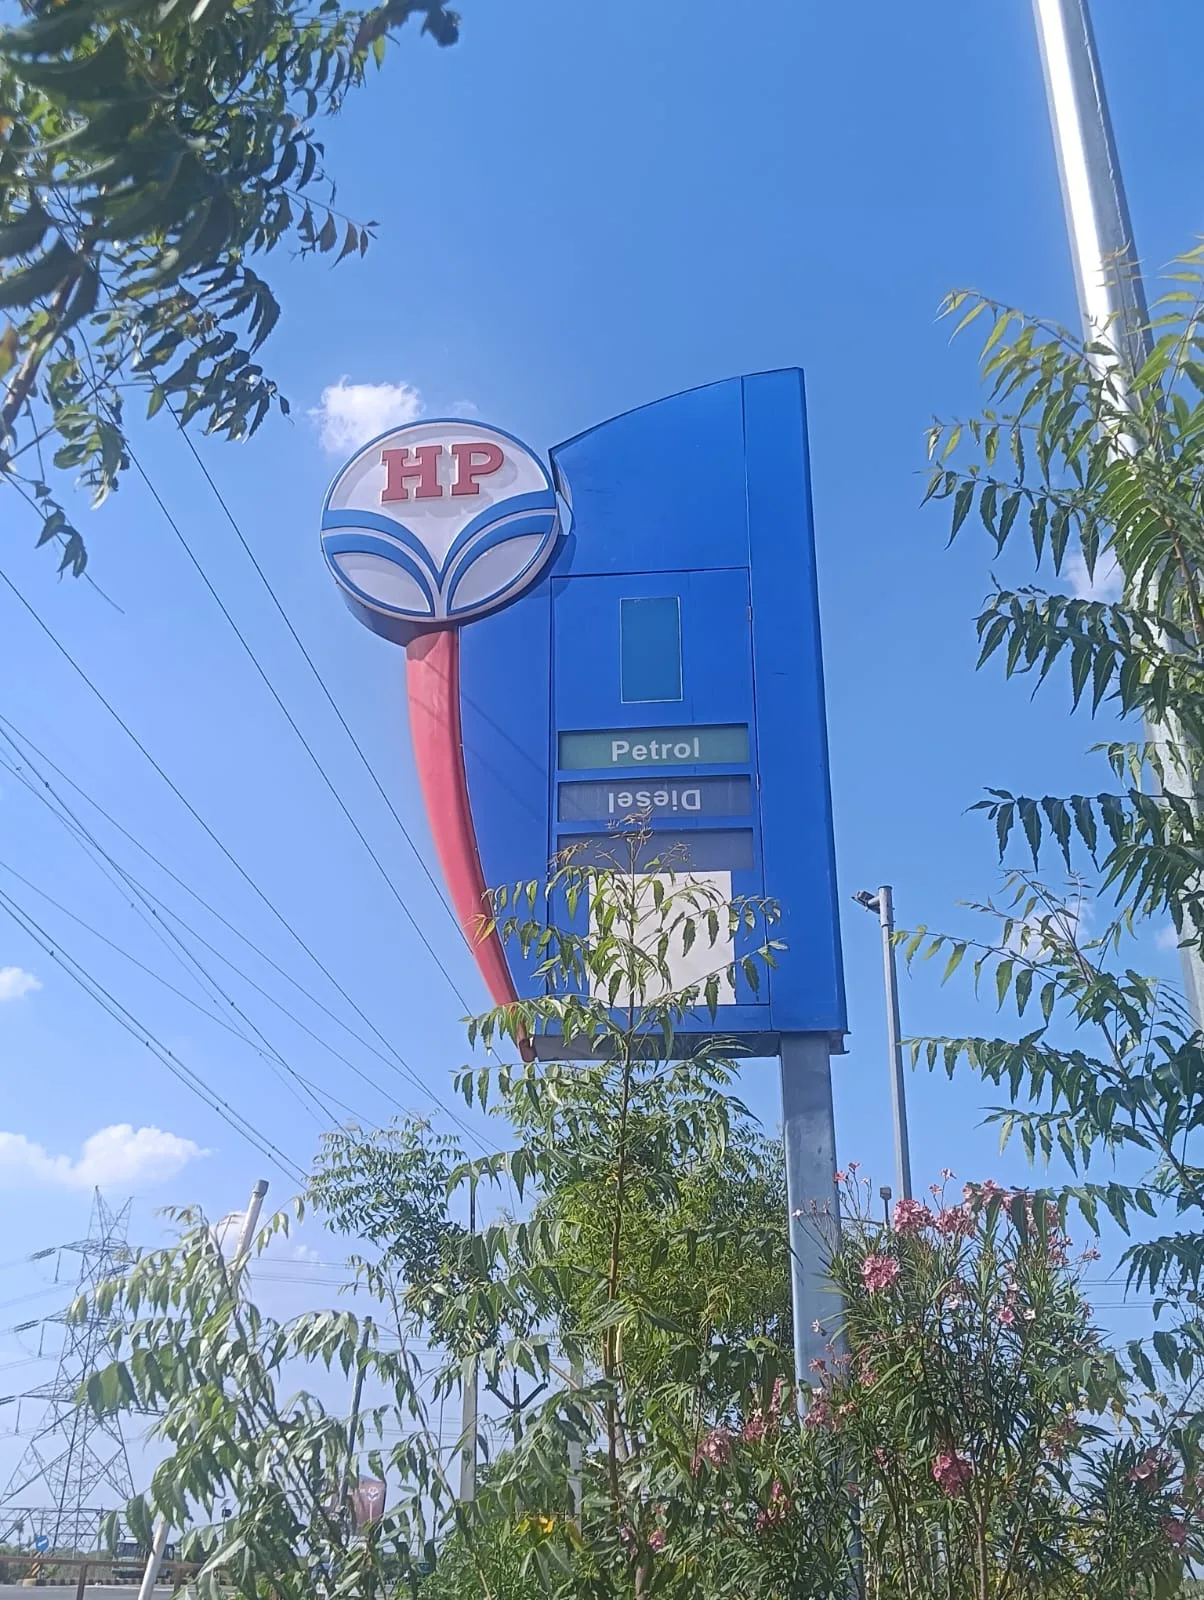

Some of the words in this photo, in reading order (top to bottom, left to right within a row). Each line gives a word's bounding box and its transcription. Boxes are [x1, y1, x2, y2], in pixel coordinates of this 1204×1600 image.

[381, 442, 504, 502] HP
[611, 737, 700, 762] Petrol
[608, 789, 701, 814] Diesel
